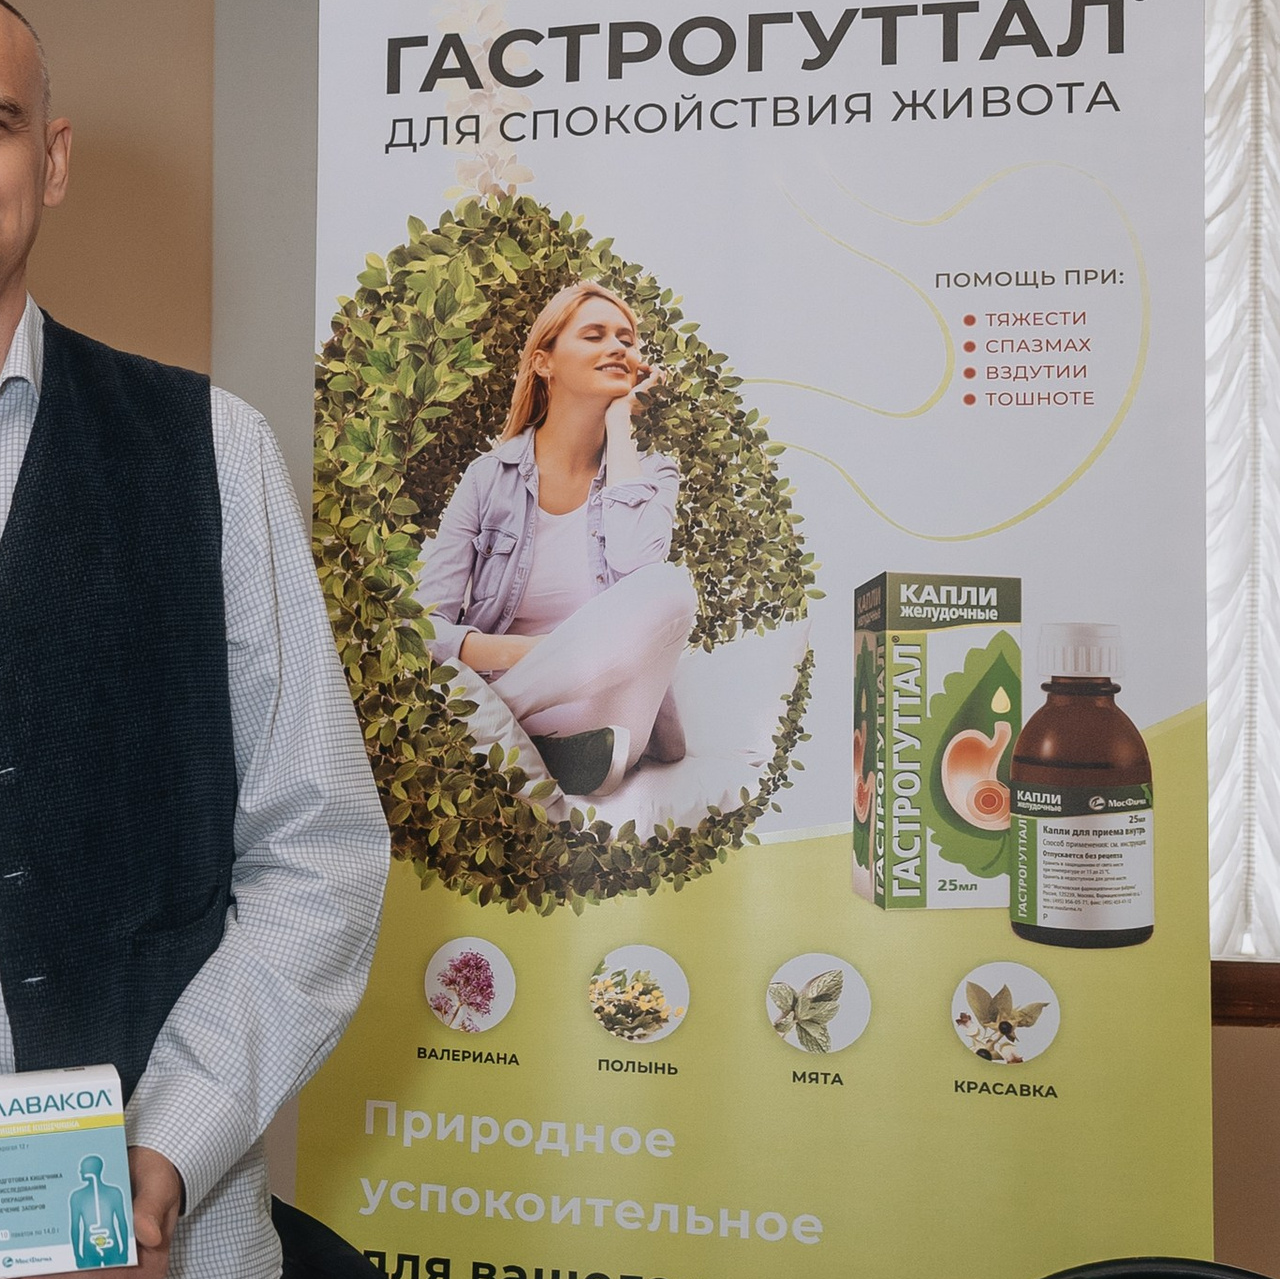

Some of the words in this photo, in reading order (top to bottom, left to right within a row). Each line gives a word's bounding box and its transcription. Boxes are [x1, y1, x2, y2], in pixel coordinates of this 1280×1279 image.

[384, 110, 481, 155] ДЛЯ
[499, 89, 873, 143] СПОКОЙСТВИЯ
[889, 78, 1121, 123] ЖИВОТА
[935, 271, 1056, 289] ПОМОЩЬ
[1065, 268, 1125, 286] ПРИ:
[985, 311, 1087, 327] ТЯЖЕСТИ
[985, 338, 1091, 354] СПАЗМАХ
[986, 364, 1087, 382] ВЗДУТИИ
[985, 391, 1095, 407] ТОШНОТЕ
[900, 583, 997, 606] КАПЛИ
[900, 605, 998, 622] желудочные
[1017, 790, 1062, 805] КАПЛИ
[1043, 825, 1070, 835] Капли
[1072, 829, 1090, 838] для
[1092, 828, 1124, 838] приема
[937, 878, 979, 893] 25мл
[416, 1046, 520, 1067] ВАЛЕРИАНА
[597, 1058, 679, 1076] ПОЛЫНЬ
[791, 1070, 844, 1087] МЯТА
[953, 1079, 1058, 1099] КРАСАВКА
[363, 1099, 676, 1159] Природное
[358, 1177, 824, 1245] успокоительное
